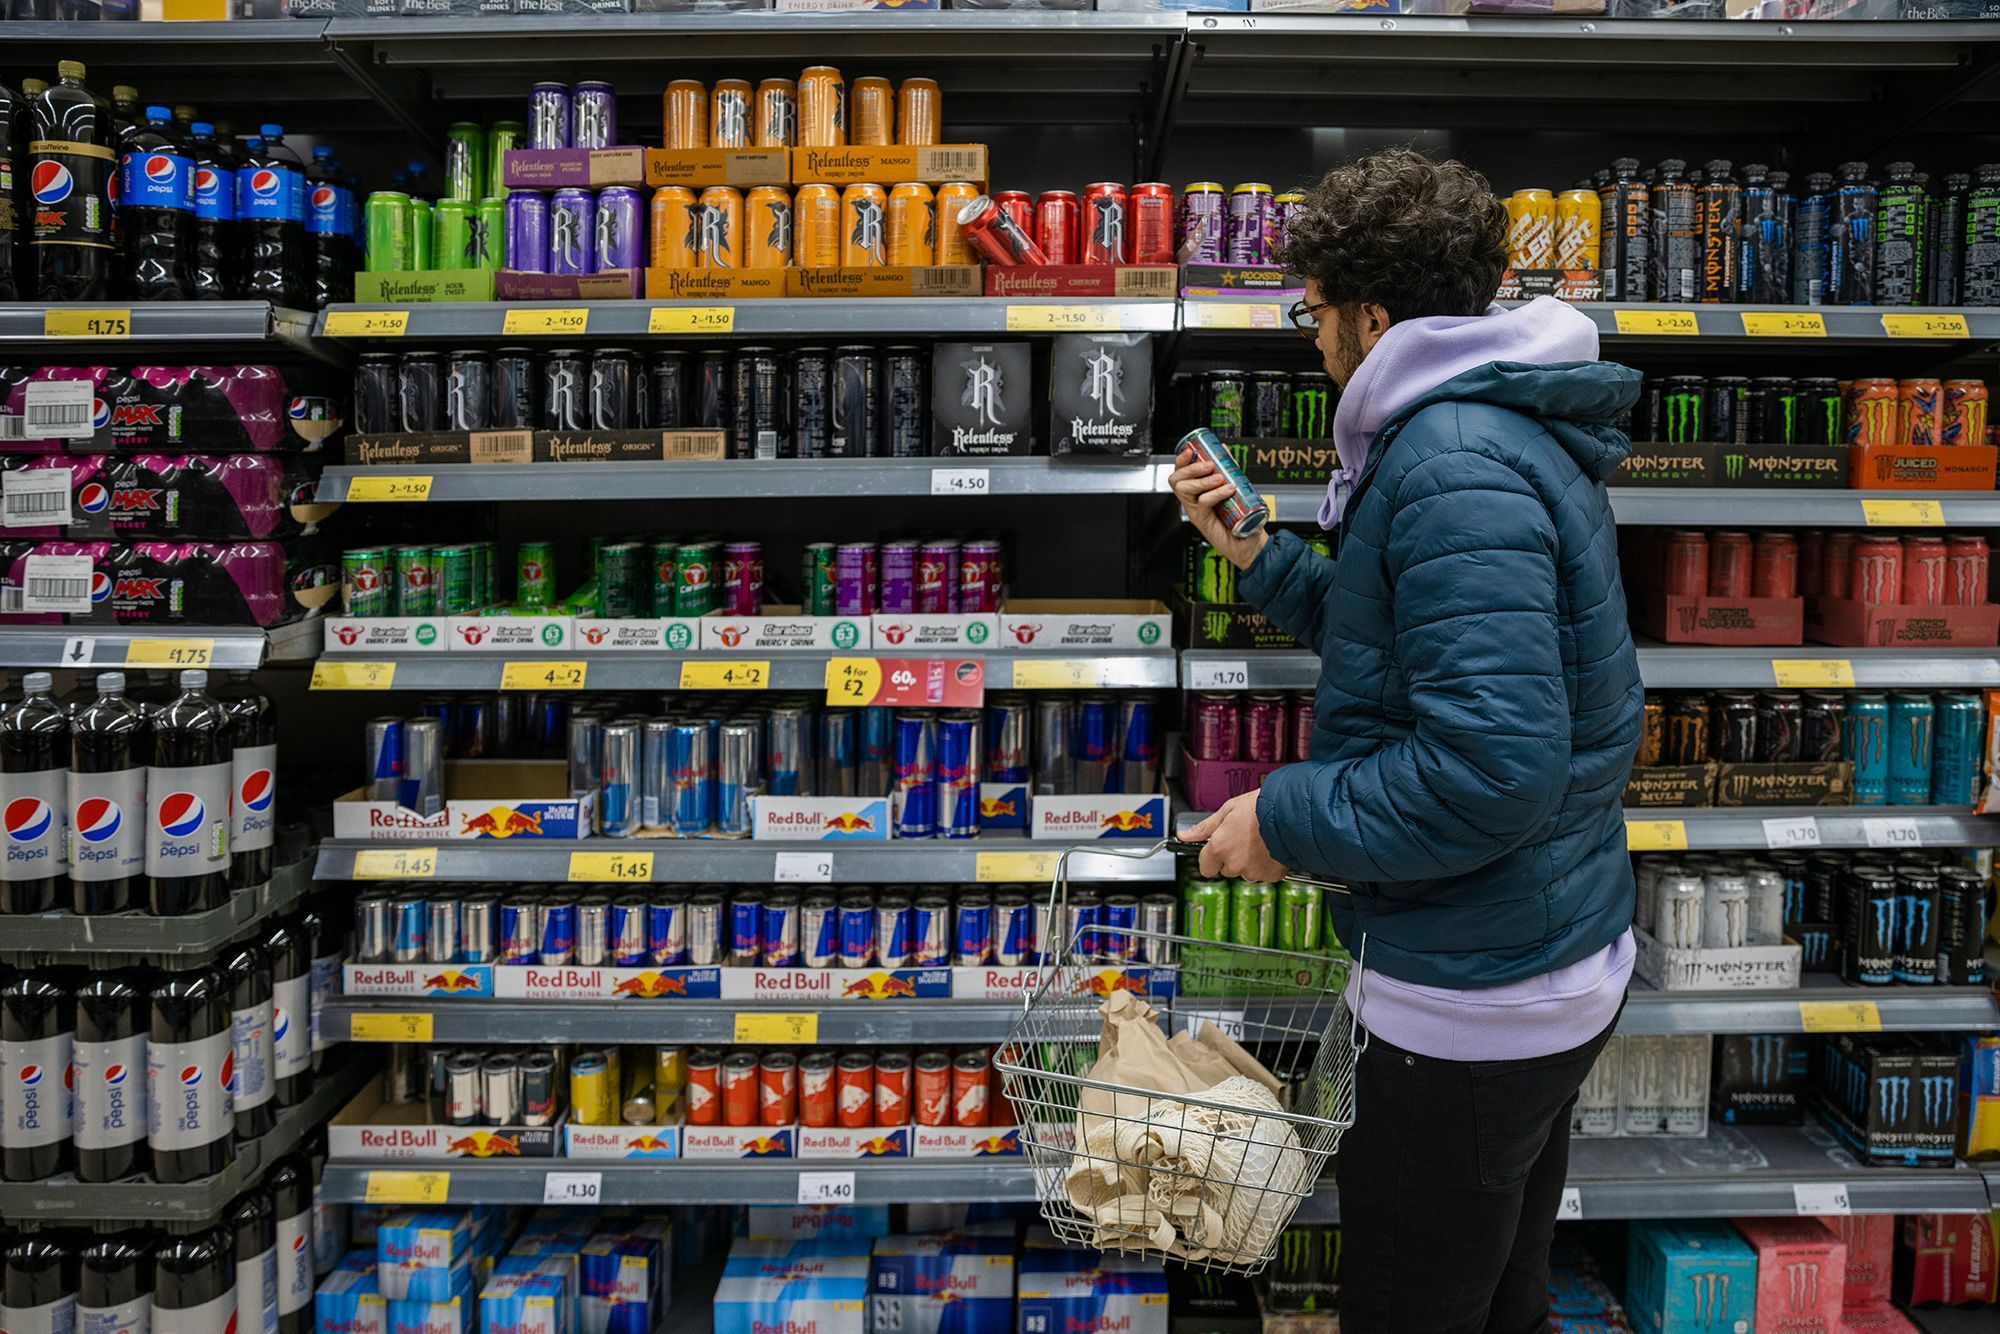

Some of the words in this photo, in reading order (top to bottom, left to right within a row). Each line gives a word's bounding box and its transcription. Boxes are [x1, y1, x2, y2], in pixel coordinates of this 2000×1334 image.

[1907, 6, 1926, 19] the
[39, 144, 70, 152] caffeine
[808, 151, 871, 177] Relentless
[148, 185, 173, 194] pepsi
[253, 198, 277, 206] pepsi
[1705, 199, 1722, 292] MONSTER
[668, 270, 732, 296] Relentless
[800, 269, 864, 294] Relentless
[874, 274, 904, 282] MANGO
[994, 270, 1058, 293] Relentless
[1068, 278, 1101, 286] CHERRY
[379, 279, 436, 302] Relentless
[1552, 288, 1602, 300] ALERT
[366, 320, 372, 328] 2
[379, 319, 402, 328] £1.50
[546, 317, 552, 326] 2
[559, 316, 583, 326] £1.50
[691, 314, 698, 324] 2
[705, 314, 729, 324] £1.50
[1048, 313, 1054, 322] 2
[1061, 312, 1086, 322] £1.50
[88, 320, 126, 336] £1.75
[1669, 320, 1693, 328] £2.50
[1796, 321, 1820, 330] £2.50
[1926, 322, 1932, 330] 2
[1938, 322, 1962, 331] £2.50
[111, 404, 167, 426] MAX
[1070, 416, 1134, 445] Relentless
[111, 436, 149, 446] CHERRY
[952, 425, 1015, 453] Relentless
[358, 440, 422, 465] Relentless
[430, 444, 460, 452] ORIGIN
[548, 435, 612, 462] Relentless
[622, 442, 652, 451] ORIGIN
[1256, 446, 1337, 468] MONST
[1618, 454, 1706, 472] MONSTER
[1748, 455, 1839, 472] MONSTER
[1894, 458, 1938, 468] JUICED
[1276, 471, 1325, 479] ENER
[1632, 472, 1689, 480] ENERGY
[1764, 472, 1822, 480] ENERGY
[389, 484, 396, 493] 2
[404, 484, 426, 493] £1.50
[950, 478, 985, 490] £4.50
[108, 488, 164, 510] MAX
[109, 521, 146, 529] CHERRY
[112, 577, 168, 600] MAX
[112, 610, 150, 618] CHERRY
[1707, 608, 1750, 618] PUNCH
[1905, 618, 1946, 628] PUNCH
[371, 627, 406, 637] Carabao
[497, 627, 532, 637] Carabao
[544, 629, 560, 640] 63
[618, 628, 657, 638] Carabao
[668, 629, 688, 642] 63
[763, 624, 812, 636] Carabao
[835, 628, 855, 642] 63
[969, 626, 985, 637] 63
[1068, 624, 1111, 636] Carabao
[1141, 626, 1158, 639] 63
[491, 636, 514, 644] ENERGY
[516, 636, 534, 644] DRINK
[755, 638, 790, 647] ENERGY
[791, 638, 816, 647] DRINK
[914, 636, 938, 644] ENERGY
[940, 636, 959, 644] DRINK
[1060, 636, 1088, 644] ENERGY
[1090, 636, 1114, 644] DRINK
[169, 649, 207, 664] £1.75
[544, 670, 555, 683] 4
[567, 670, 581, 683] £2
[723, 670, 734, 683] 4
[746, 669, 760, 683] £2
[843, 666, 852, 675] 4
[854, 668, 868, 676] for
[1214, 670, 1246, 684] £1.70
[890, 670, 917, 686] 60p
[844, 680, 864, 696] £2
[1628, 780, 1698, 792] MONSTER
[1752, 775, 1828, 788] MONSTER
[1640, 792, 1685, 800] MULE
[768, 812, 793, 825] Red
[796, 812, 820, 825] Bull
[1044, 812, 1070, 824] Red
[1072, 810, 1098, 822] Bull
[1787, 828, 1816, 841] £1.70
[1886, 828, 1916, 842] £1.70
[7, 847, 49, 863] pepsi
[78, 848, 118, 863] pepsi
[160, 844, 200, 858] pepsi
[395, 858, 430, 874] £1.45
[611, 864, 648, 877] £1.45
[818, 864, 830, 876] £2
[1704, 960, 1786, 974] MONSTER
[354, 970, 383, 984] Red
[386, 970, 414, 984] Bull
[526, 970, 562, 988] Red
[566, 970, 601, 988] Bull
[755, 972, 792, 990] Red
[795, 972, 831, 990] Bull
[1731, 1092, 1796, 1105] MONSTER
[27, 1087, 40, 1129] pepsi
[112, 1086, 126, 1129] pepsi
[188, 1088, 202, 1130] pepsi
[360, 1129, 398, 1147] Red
[402, 1129, 437, 1146] Bull
[573, 1134, 595, 1145] Red
[597, 1134, 620, 1145] Bull
[688, 1134, 710, 1147] Red
[712, 1134, 734, 1146] Bull
[803, 1137, 826, 1149] Red
[828, 1137, 851, 1148] Bull
[918, 1134, 942, 1148] Red
[944, 1134, 966, 1147] Bull
[383, 1150, 416, 1158] ZERO
[566, 1184, 596, 1198] £1.30
[820, 1184, 851, 1198] £1.40
[1566, 1199, 1579, 1212] £5
[1835, 1195, 1848, 1208] £5
[1778, 1317, 1823, 1326] PUNCH
